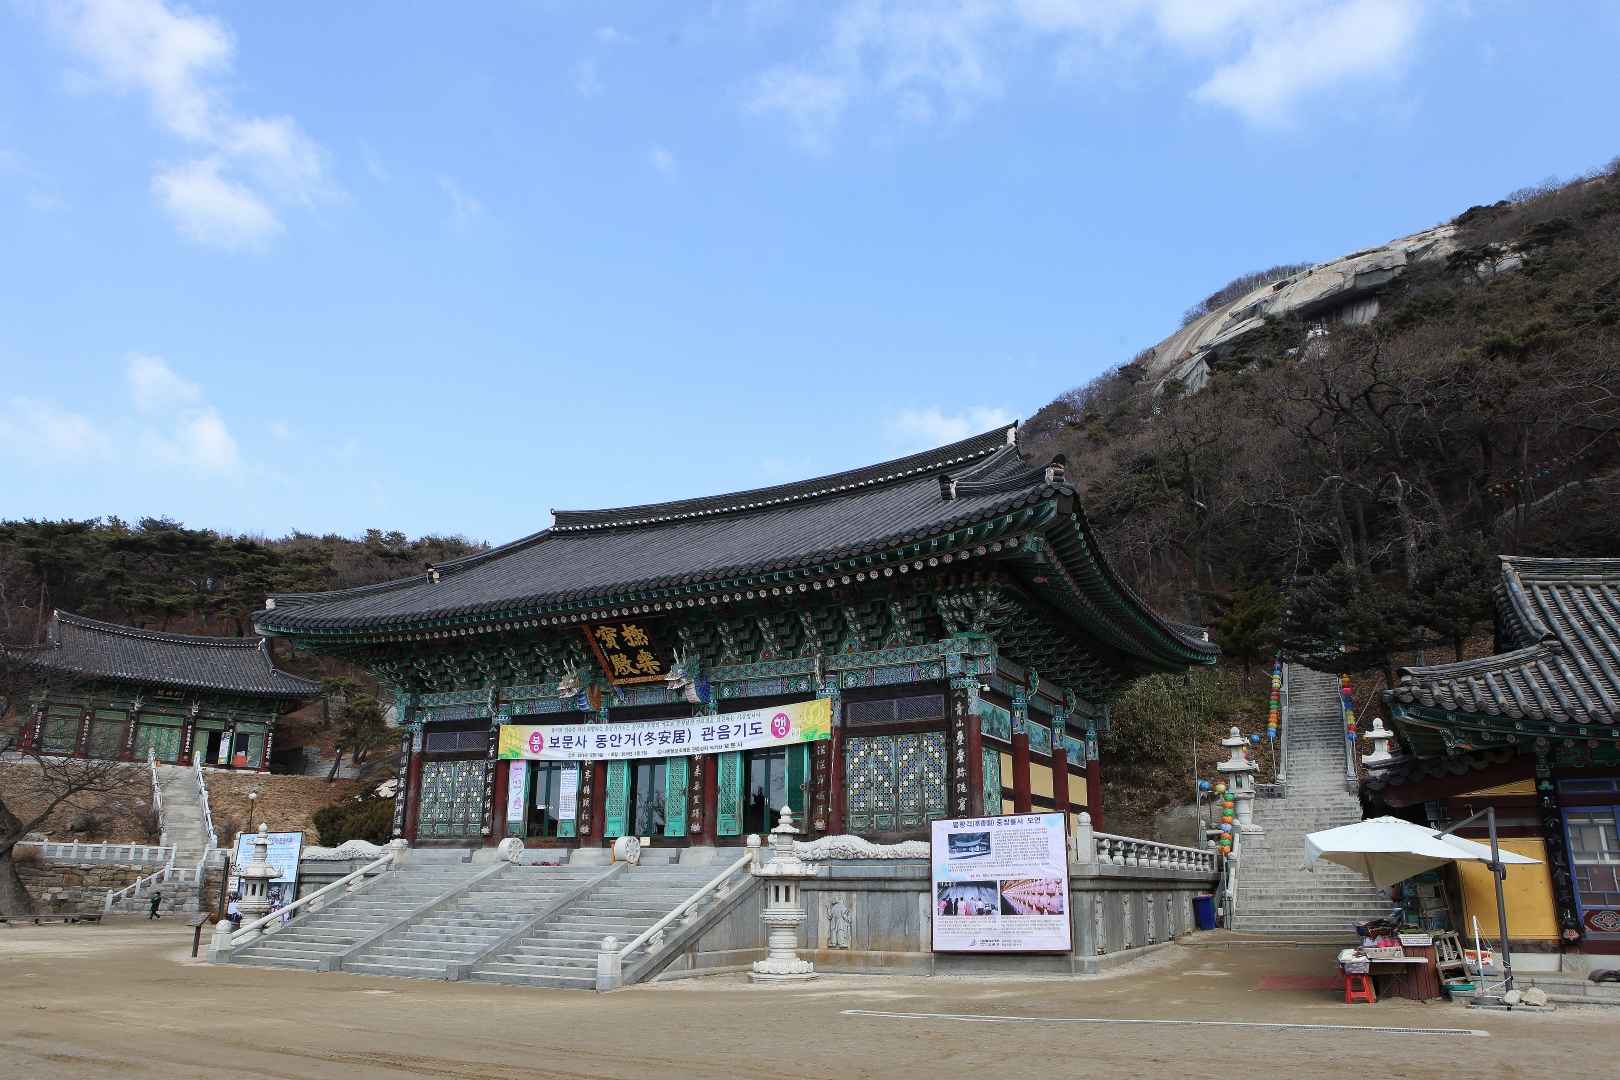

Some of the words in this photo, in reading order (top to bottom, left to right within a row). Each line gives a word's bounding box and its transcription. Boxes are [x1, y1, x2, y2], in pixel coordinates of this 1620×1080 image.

[548, 735, 588, 749] 보문사
[595, 728, 692, 749] 동안거(冬安居)
[701, 721, 764, 742] 관음기도
[773, 715, 787, 736] 행
[530, 735, 543, 751] 봉
